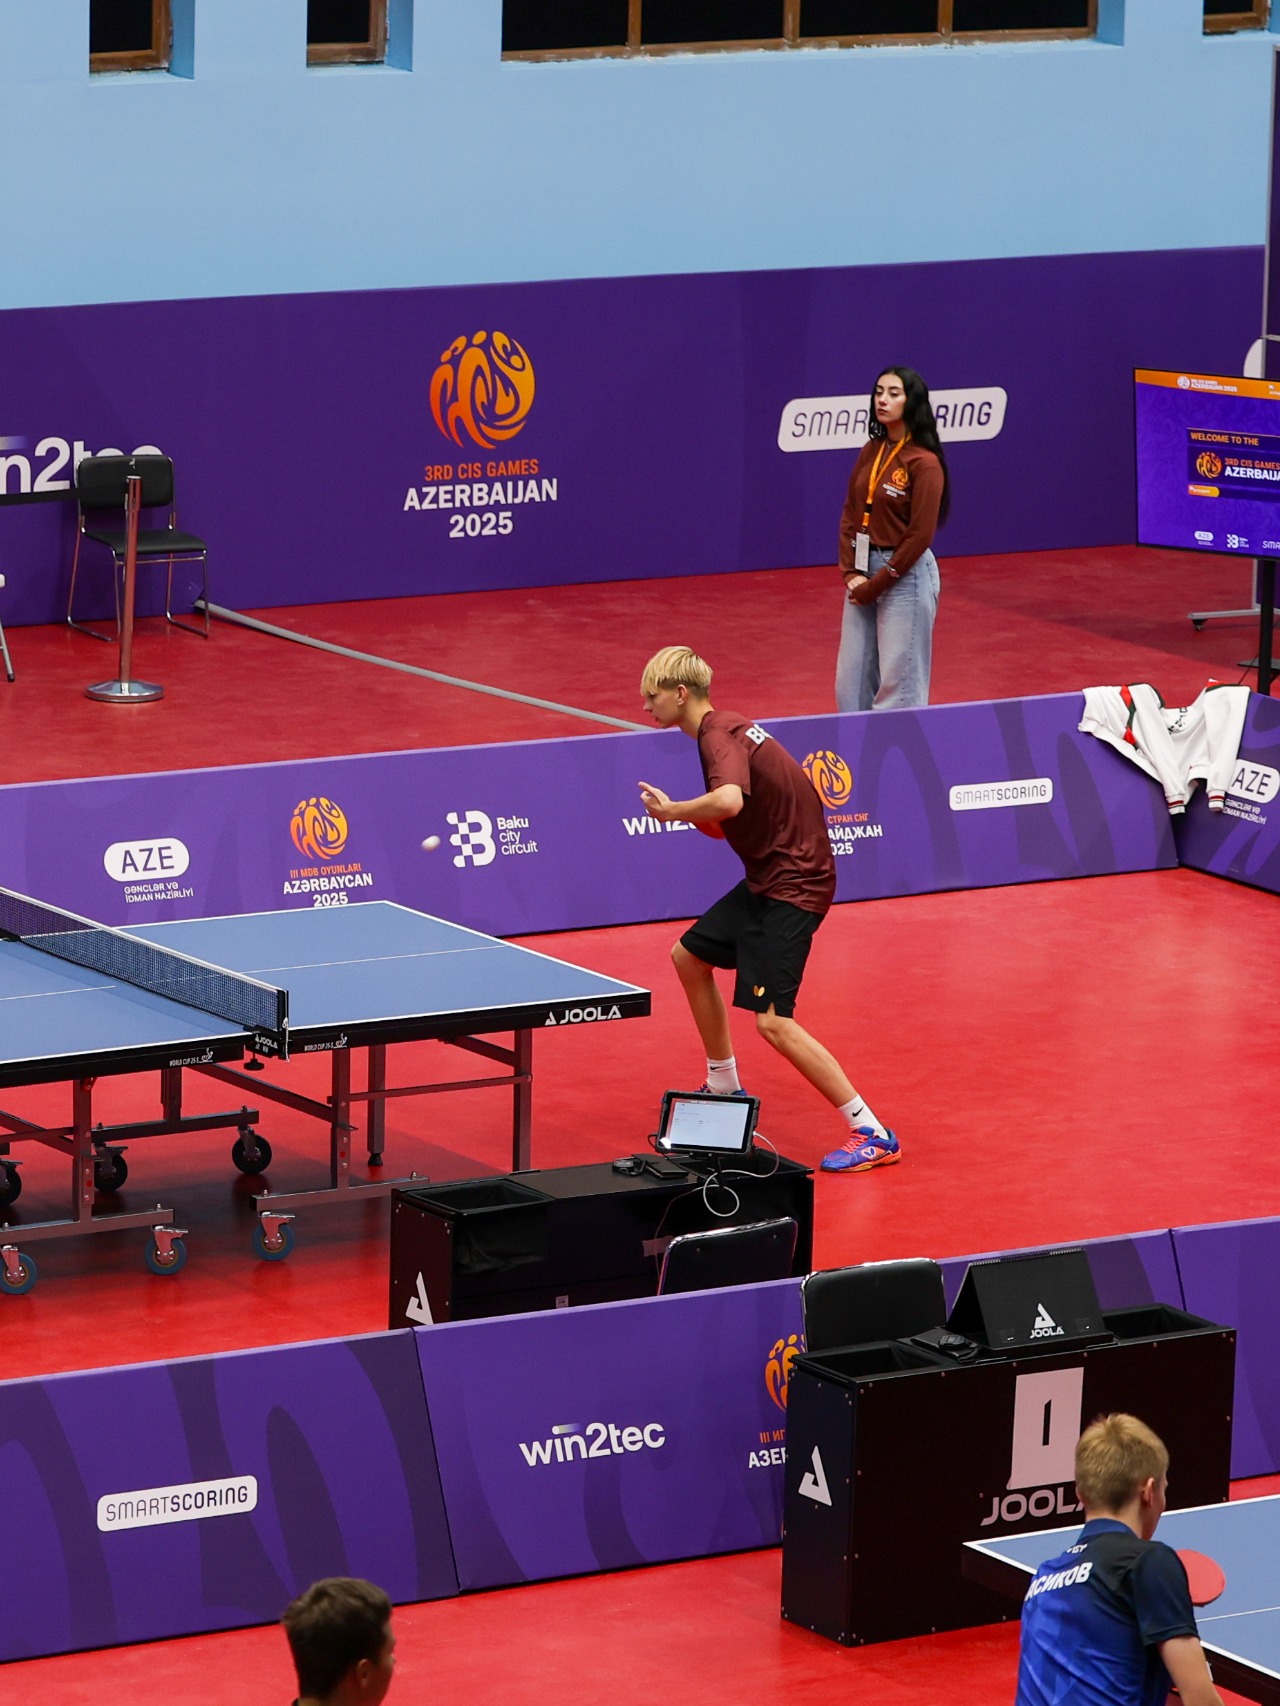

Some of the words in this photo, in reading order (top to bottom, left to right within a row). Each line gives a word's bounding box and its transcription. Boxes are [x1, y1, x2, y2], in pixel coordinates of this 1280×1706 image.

[792, 401, 992, 438] SMARRING
[1190, 432, 1229, 443] WELCOME
[1231, 436, 1241, 444] TO
[1243, 437, 1259, 446] THE
[425, 465, 453, 482] 3RD
[458, 462, 482, 479] CIS
[486, 459, 539, 477] GAMES
[1224, 457, 1239, 466] 3RD
[1240, 459, 1253, 468] CIS
[1254, 461, 1280, 470] GAMES
[403, 478, 557, 511] AZERBAIJAN
[449, 511, 513, 538] 2025
[1231, 768, 1271, 796] AZE
[955, 785, 1047, 804] SMARTSCORING
[496, 815, 529, 830] Baku
[827, 814, 853, 824] СТРАН
[854, 813, 869, 822] СНГ
[499, 829, 521, 844] city
[827, 824, 883, 841] АЙДЖАН
[501, 840, 539, 855] circuit
[122, 846, 174, 874] AZE
[301, 868, 319, 878] MDB
[321, 863, 362, 875] OYUNLARI
[124, 883, 165, 894] GƏNCLƏR
[166, 881, 178, 891] VƏ
[283, 873, 373, 894] AZƏRBAYCAN
[125, 892, 153, 903] İDMAN
[313, 892, 348, 907] 2025
[559, 1005, 622, 1024] JOOLA
[259, 1036, 278, 1049] JOOLA
[1030, 1326, 1064, 1339] JOOLA
[519, 1422, 665, 1467] win2tec
[106, 1485, 249, 1522] SMARTSCORING
[980, 1487, 1084, 1526] JOOL
[1024, 1562, 1093, 1601] АСИКОВ
